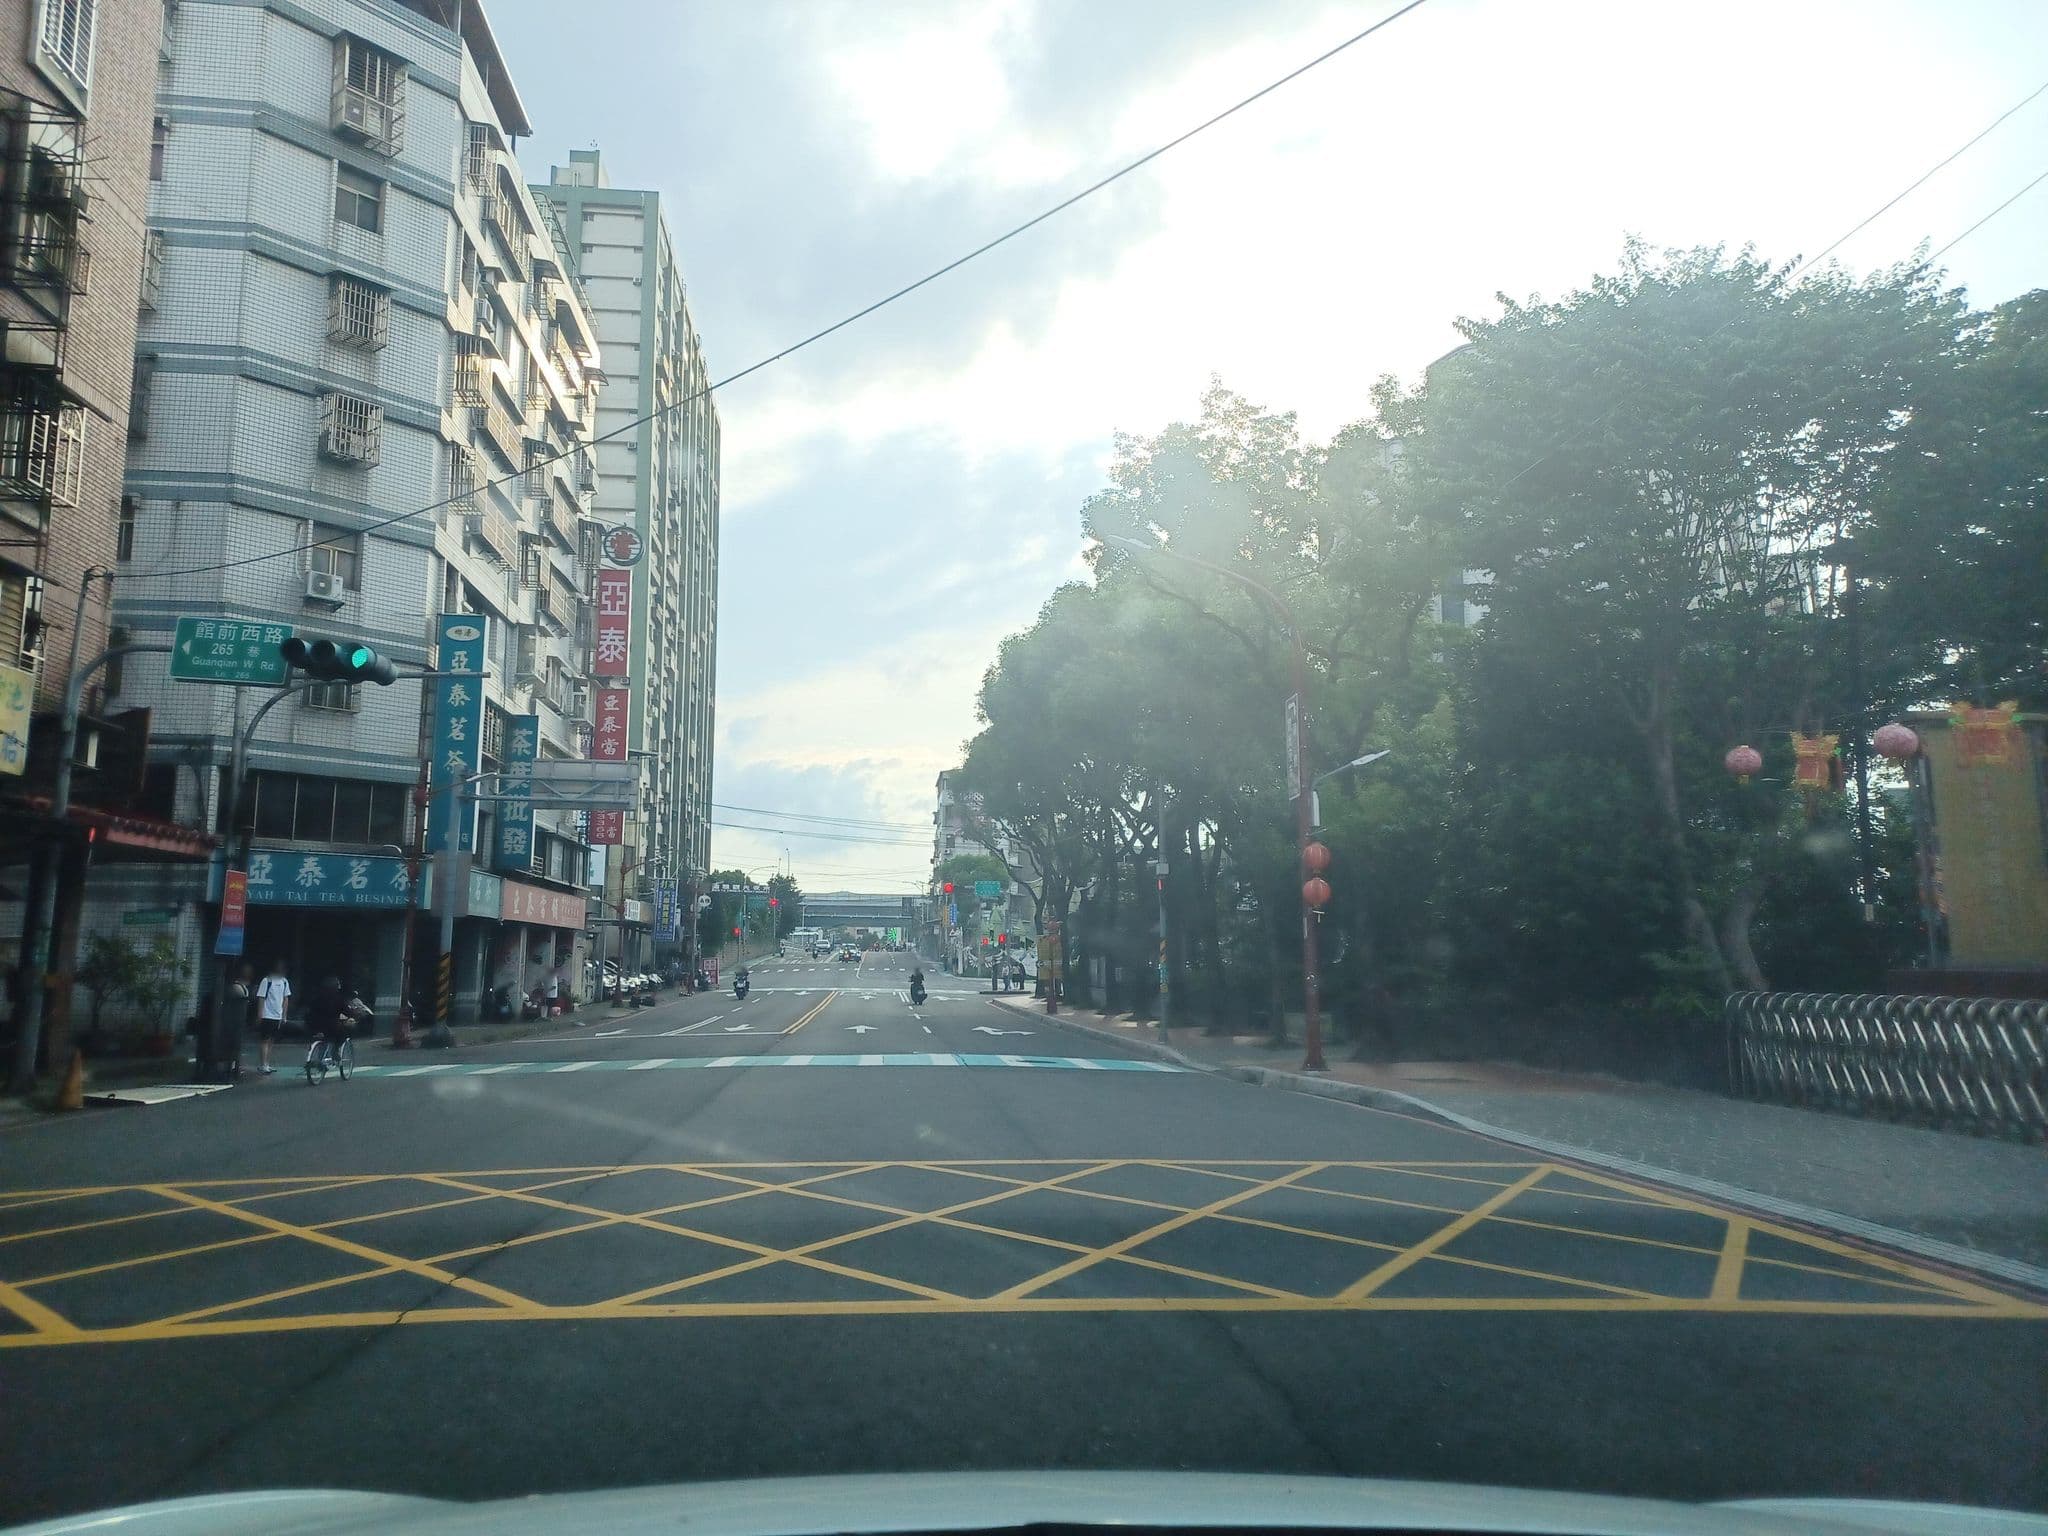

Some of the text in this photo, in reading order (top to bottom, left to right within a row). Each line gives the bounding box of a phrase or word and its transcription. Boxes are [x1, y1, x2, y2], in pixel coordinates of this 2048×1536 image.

[598, 581, 628, 663] 亞泰
[195, 620, 284, 644] 館前西路
[211, 643, 261, 658] 265 巷
[191, 656, 238, 668] Guanqian
[287, 891, 308, 901] TAI
[320, 892, 345, 902] TEA
